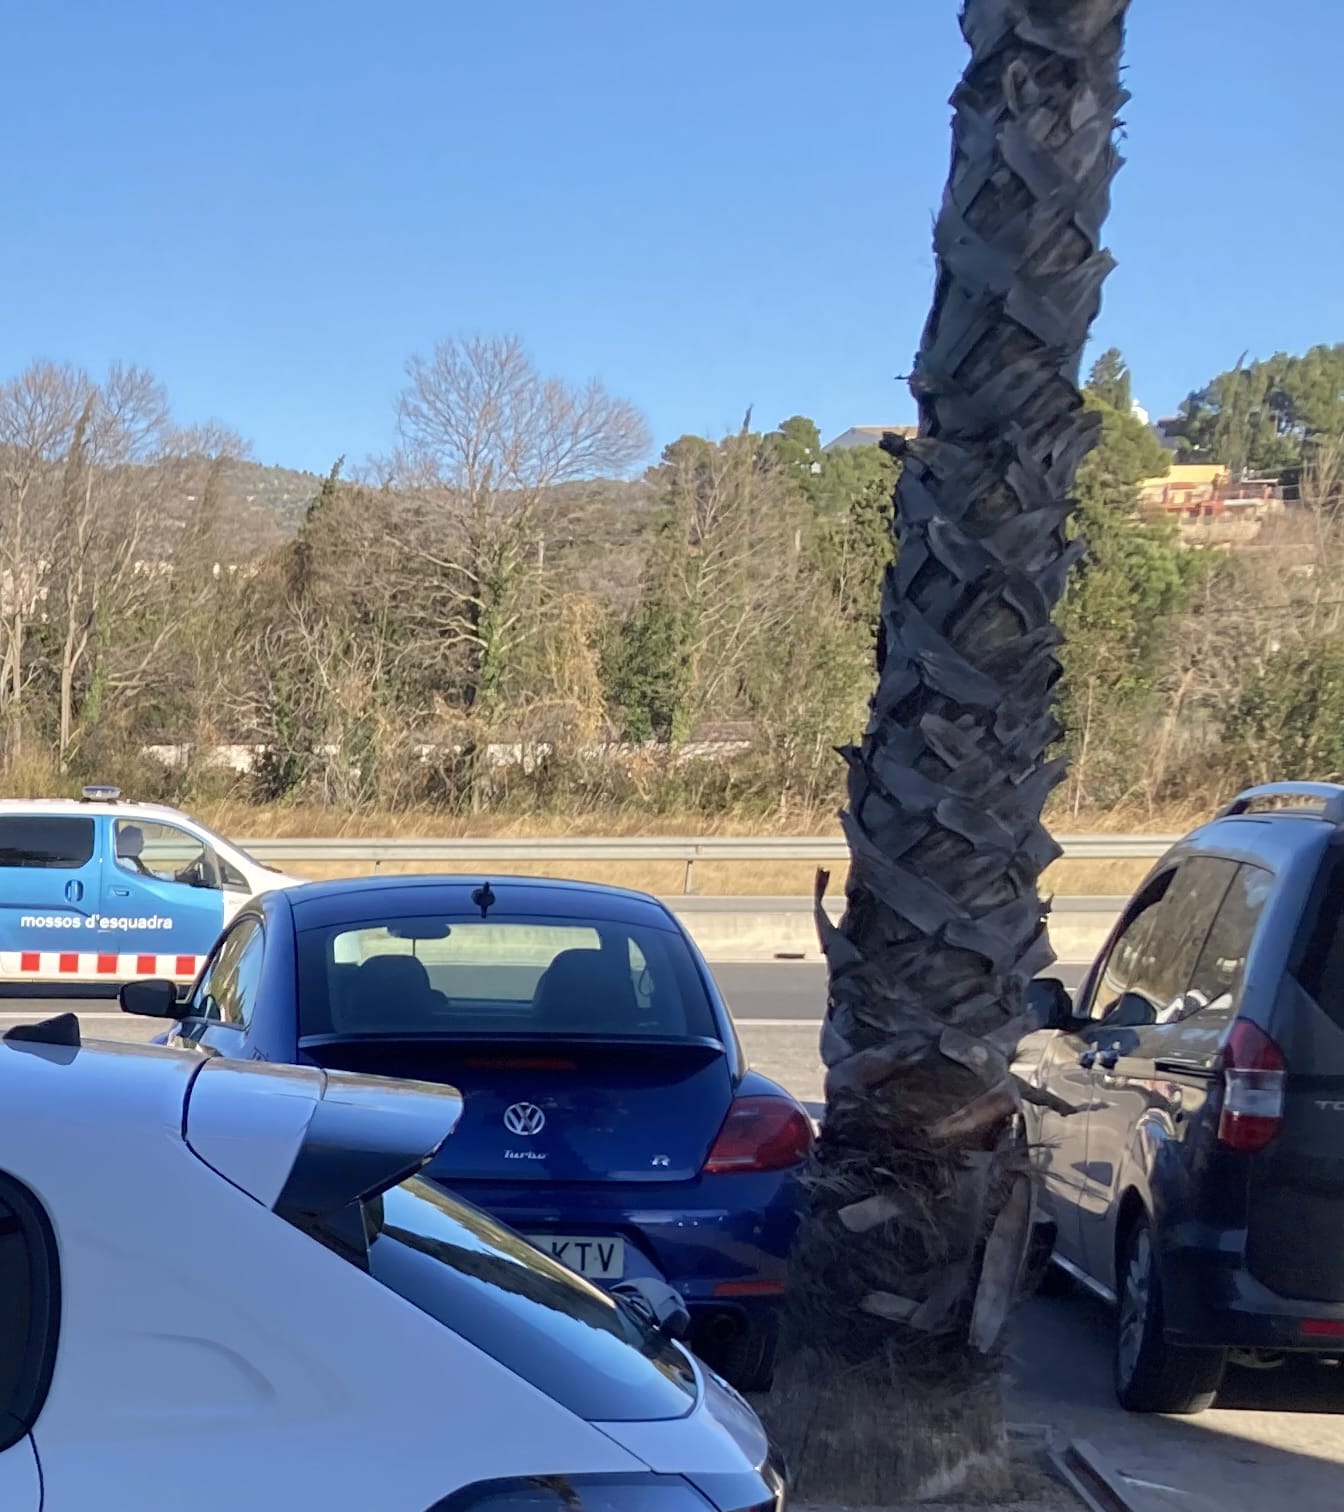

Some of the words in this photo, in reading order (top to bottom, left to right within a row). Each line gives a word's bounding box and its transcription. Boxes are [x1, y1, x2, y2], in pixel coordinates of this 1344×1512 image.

[21, 915, 81, 929] mossos
[85, 914, 173, 932] d'esquadra
[504, 1150, 549, 1160] Turbo
[551, 1241, 615, 1272] KTV
